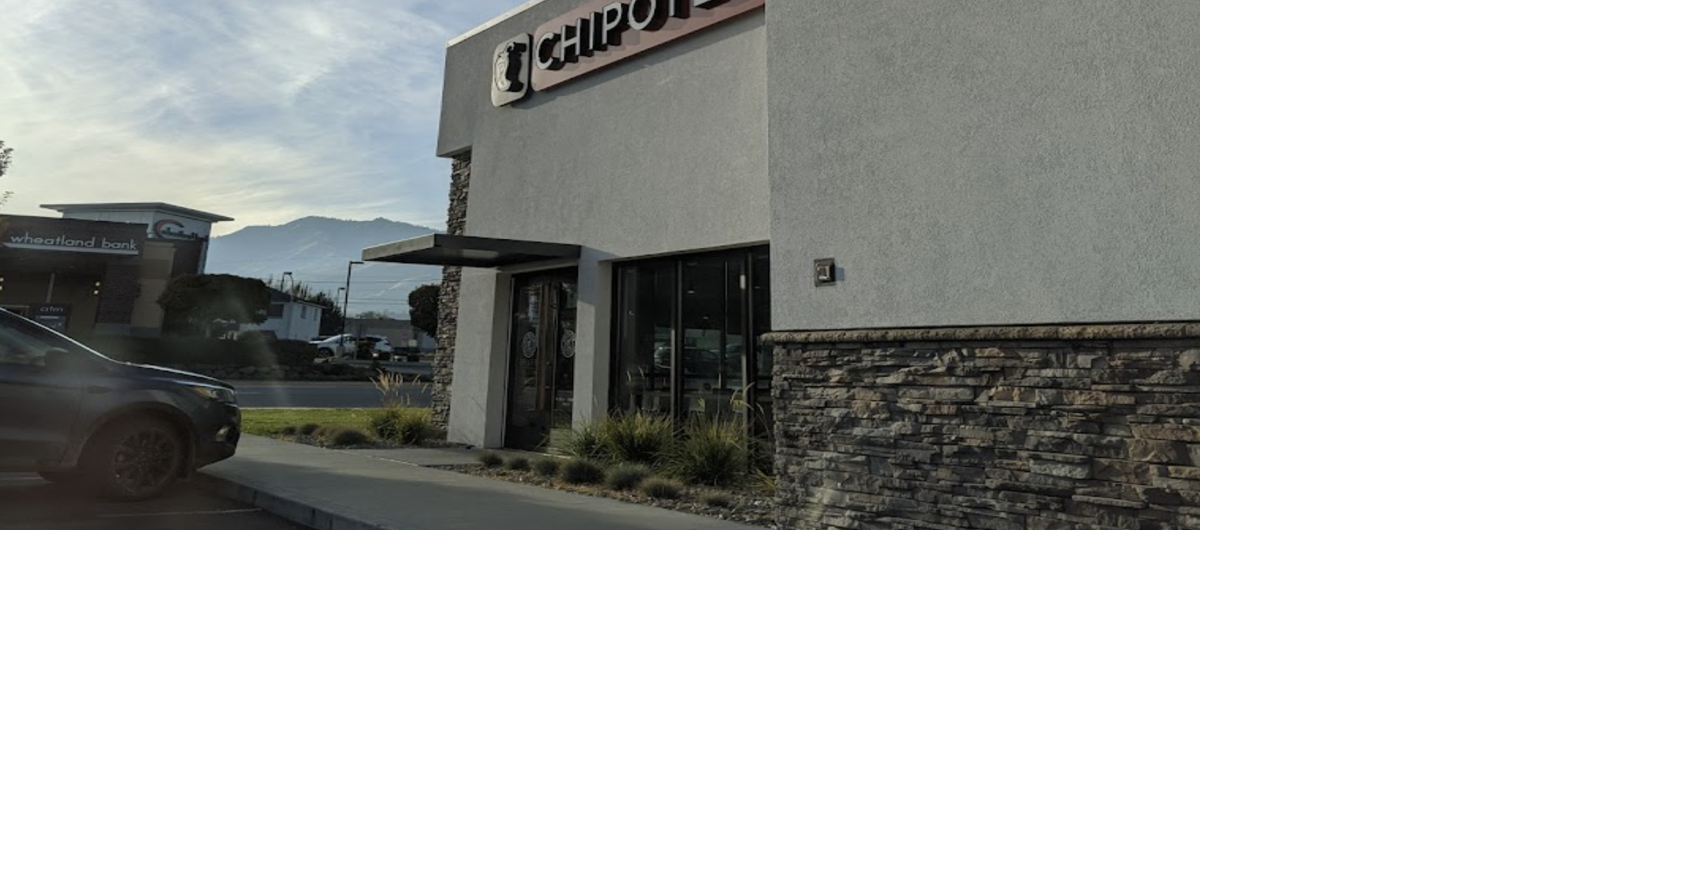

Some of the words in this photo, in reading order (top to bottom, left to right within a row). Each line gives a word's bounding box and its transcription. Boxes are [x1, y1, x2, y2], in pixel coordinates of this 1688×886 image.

[535, 0, 716, 70] CHIPO
[10, 231, 95, 248] wheatland
[101, 237, 137, 250] bank
